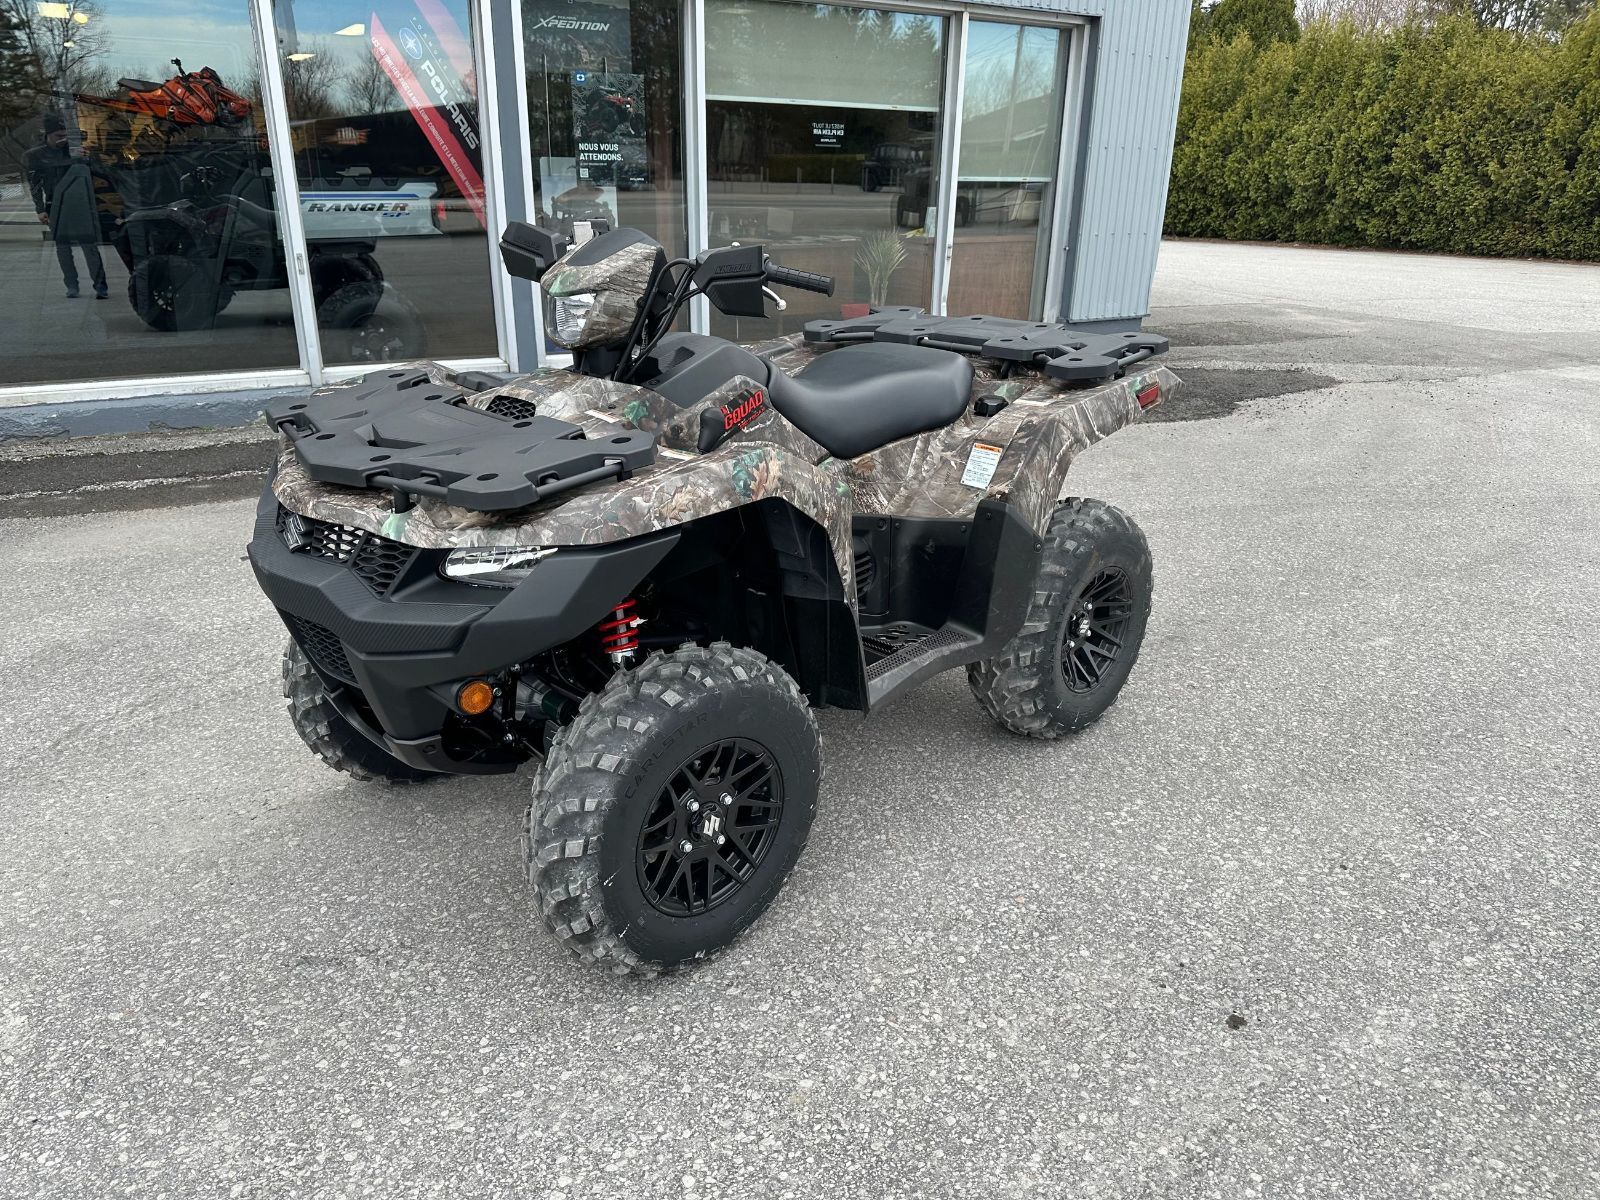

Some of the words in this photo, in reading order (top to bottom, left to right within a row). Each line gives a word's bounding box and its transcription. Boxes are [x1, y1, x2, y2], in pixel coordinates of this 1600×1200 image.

[532, 15, 610, 31] XPEDITION
[420, 60, 479, 150] POLARIS
[578, 143, 598, 151] NOUS
[600, 143, 619, 151] VOUS
[580, 153, 624, 161] ATTENDONS.
[308, 202, 408, 212] RANGER
[624, 712, 707, 799] CARLSTAR
